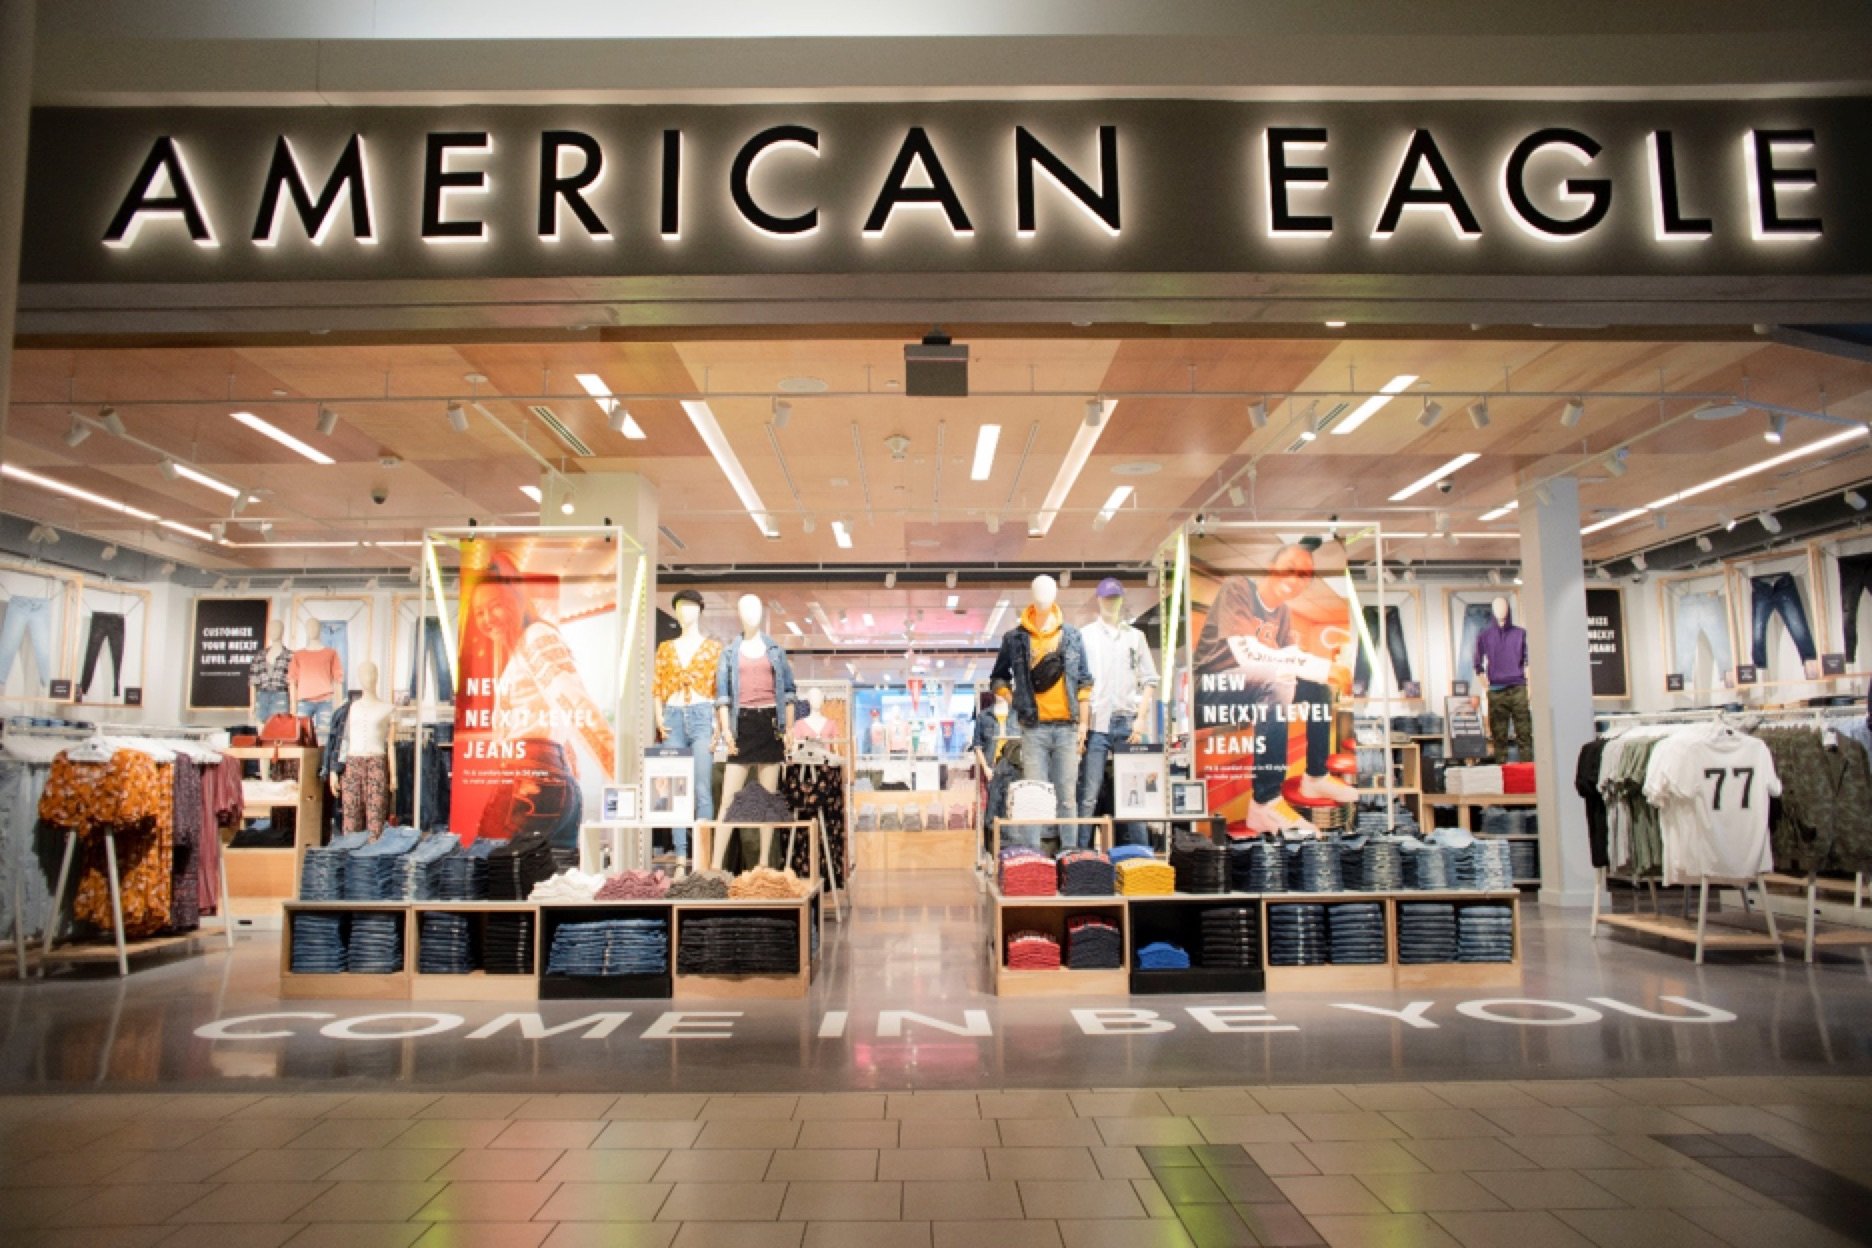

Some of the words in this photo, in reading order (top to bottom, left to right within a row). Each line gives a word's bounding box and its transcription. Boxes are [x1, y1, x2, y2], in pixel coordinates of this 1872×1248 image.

[103, 124, 1122, 248] AMERICAN
[1262, 125, 1824, 243] EAGLE
[466, 677, 511, 697] NEW
[1202, 673, 1246, 692] NEW
[538, 708, 596, 728] LEVEL
[1203, 703, 1270, 725] NE(X)T
[1275, 703, 1333, 722] LEVEL
[463, 741, 527, 760] JEANS
[1203, 735, 1267, 755] JEANS
[1703, 767, 1755, 811] 77
[193, 1010, 745, 1040] COME
[817, 1008, 994, 1038] IN
[1070, 1004, 1300, 1035] BE
[1328, 996, 1739, 1029] YOU
